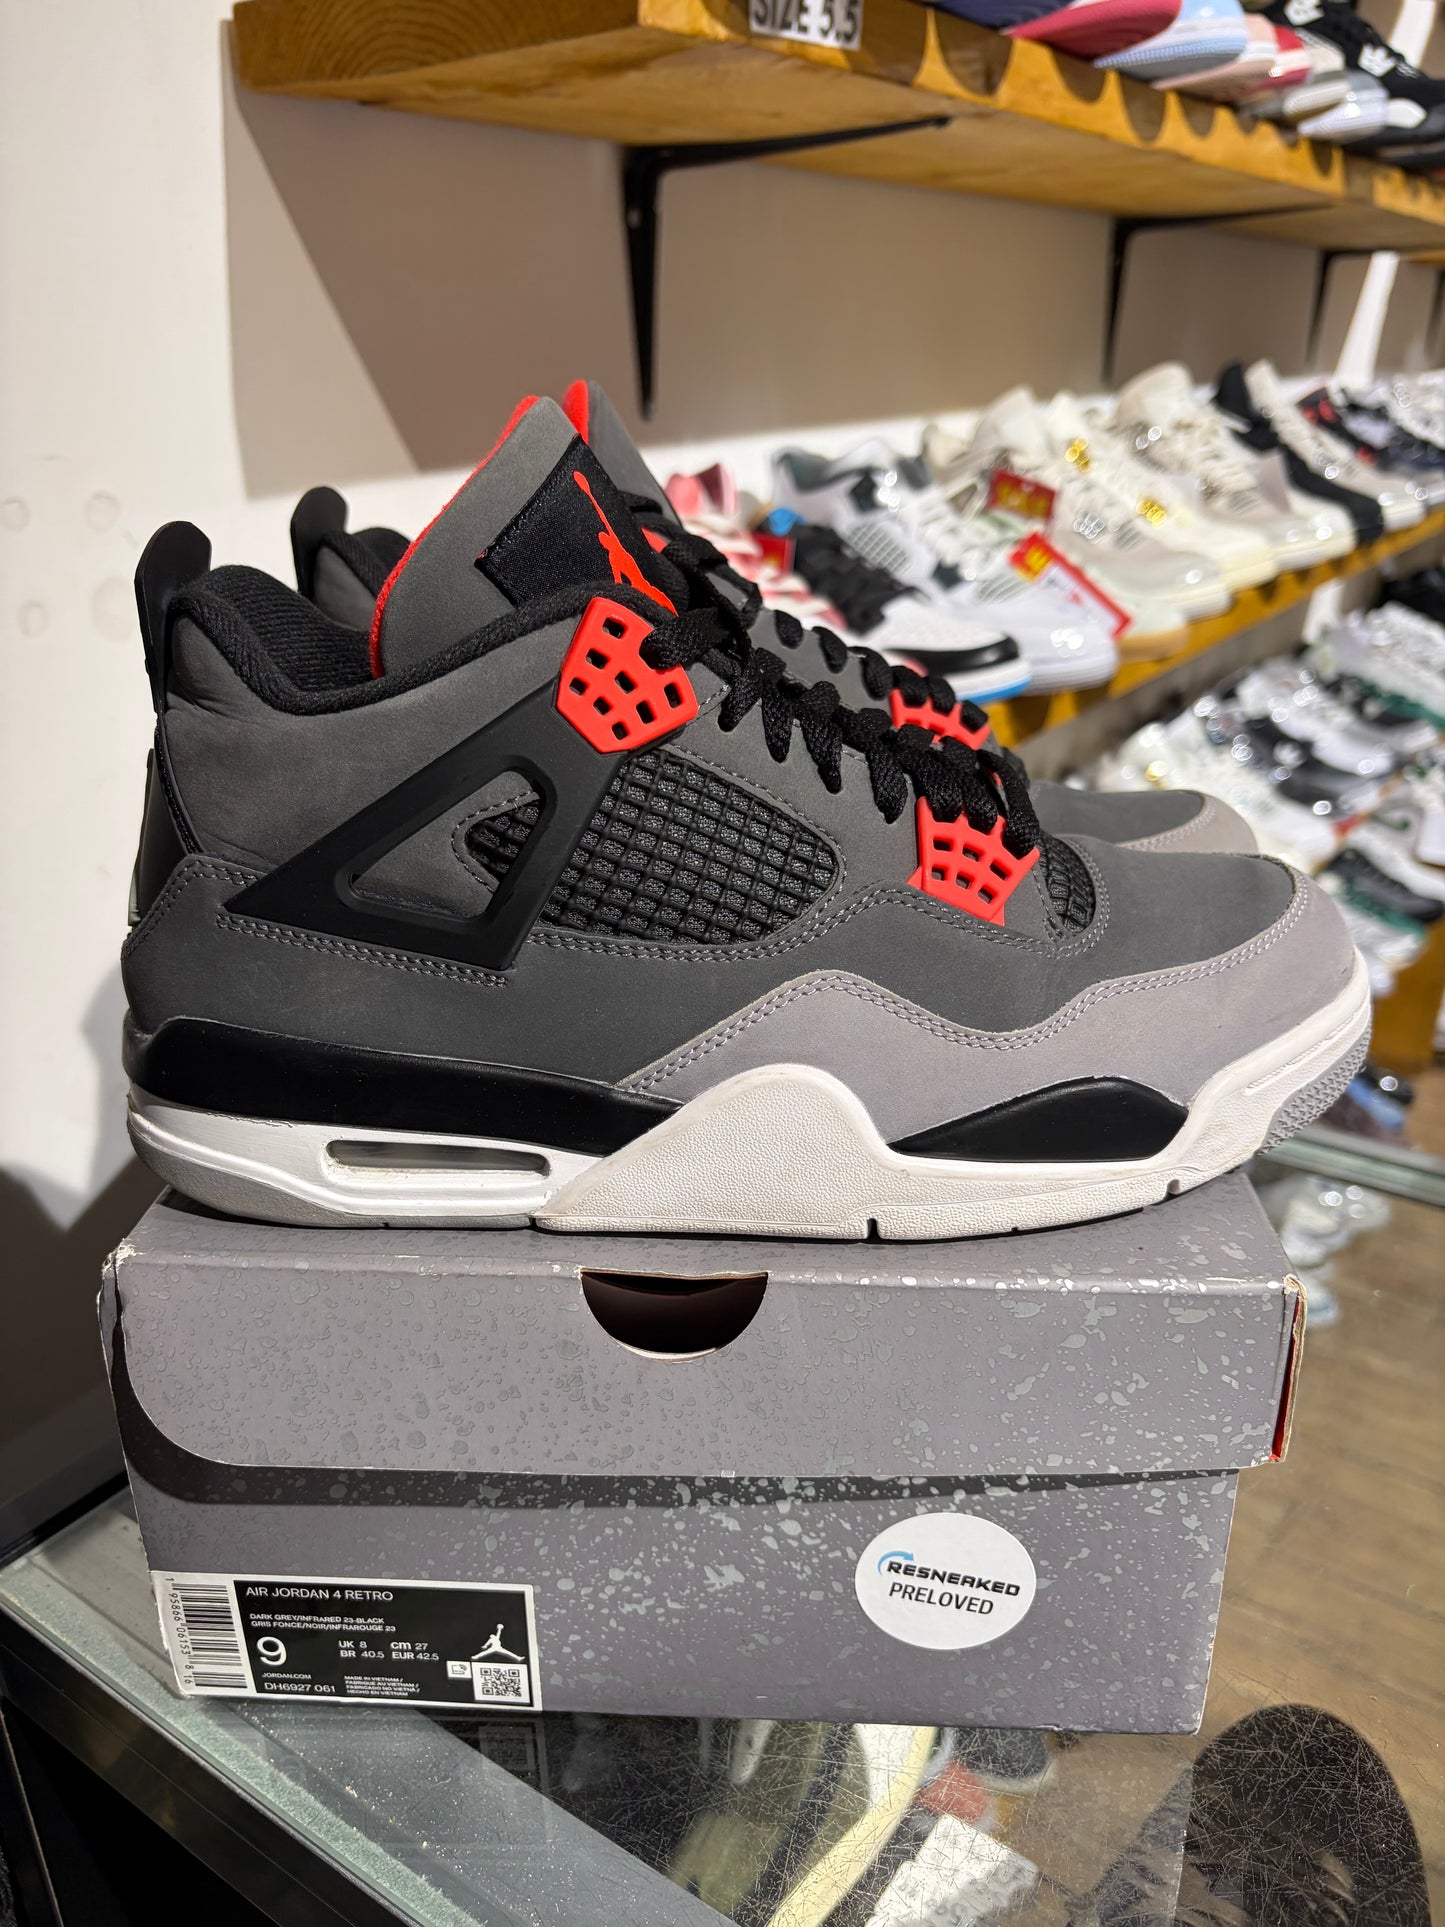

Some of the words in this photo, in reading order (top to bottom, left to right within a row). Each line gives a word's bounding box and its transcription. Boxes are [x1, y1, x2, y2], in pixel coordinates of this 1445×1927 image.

[886, 1560, 1021, 1597] RESNEAKED
[246, 1586, 269, 1597] AIR
[271, 1587, 330, 1599] JORDAN
[332, 1589, 342, 1599] 4
[345, 1589, 394, 1601] RETRO
[888, 1581, 994, 1615] PRELOVED
[169, 1592, 182, 1622] 95866
[176, 1627, 191, 1655] 06153
[274, 1614, 342, 1623] GREY/INFRARED
[343, 1616, 385, 1624] 23-BLACK
[273, 1621, 384, 1632] FONCE/NOIR/INFRAROUGE
[338, 1640, 355, 1649] UK
[359, 1640, 368, 1649] 8
[390, 1641, 412, 1650] cm
[414, 1642, 428, 1650] 27
[256, 1636, 287, 1666] 9
[339, 1649, 357, 1658] BR
[361, 1650, 385, 1659] 40.5
[391, 1651, 415, 1660] EUR
[416, 1652, 440, 1661] 42.5
[261, 1672, 312, 1680] JORDAN.COM
[264, 1682, 312, 1692] DH6927
[314, 1684, 336, 1693] 061
